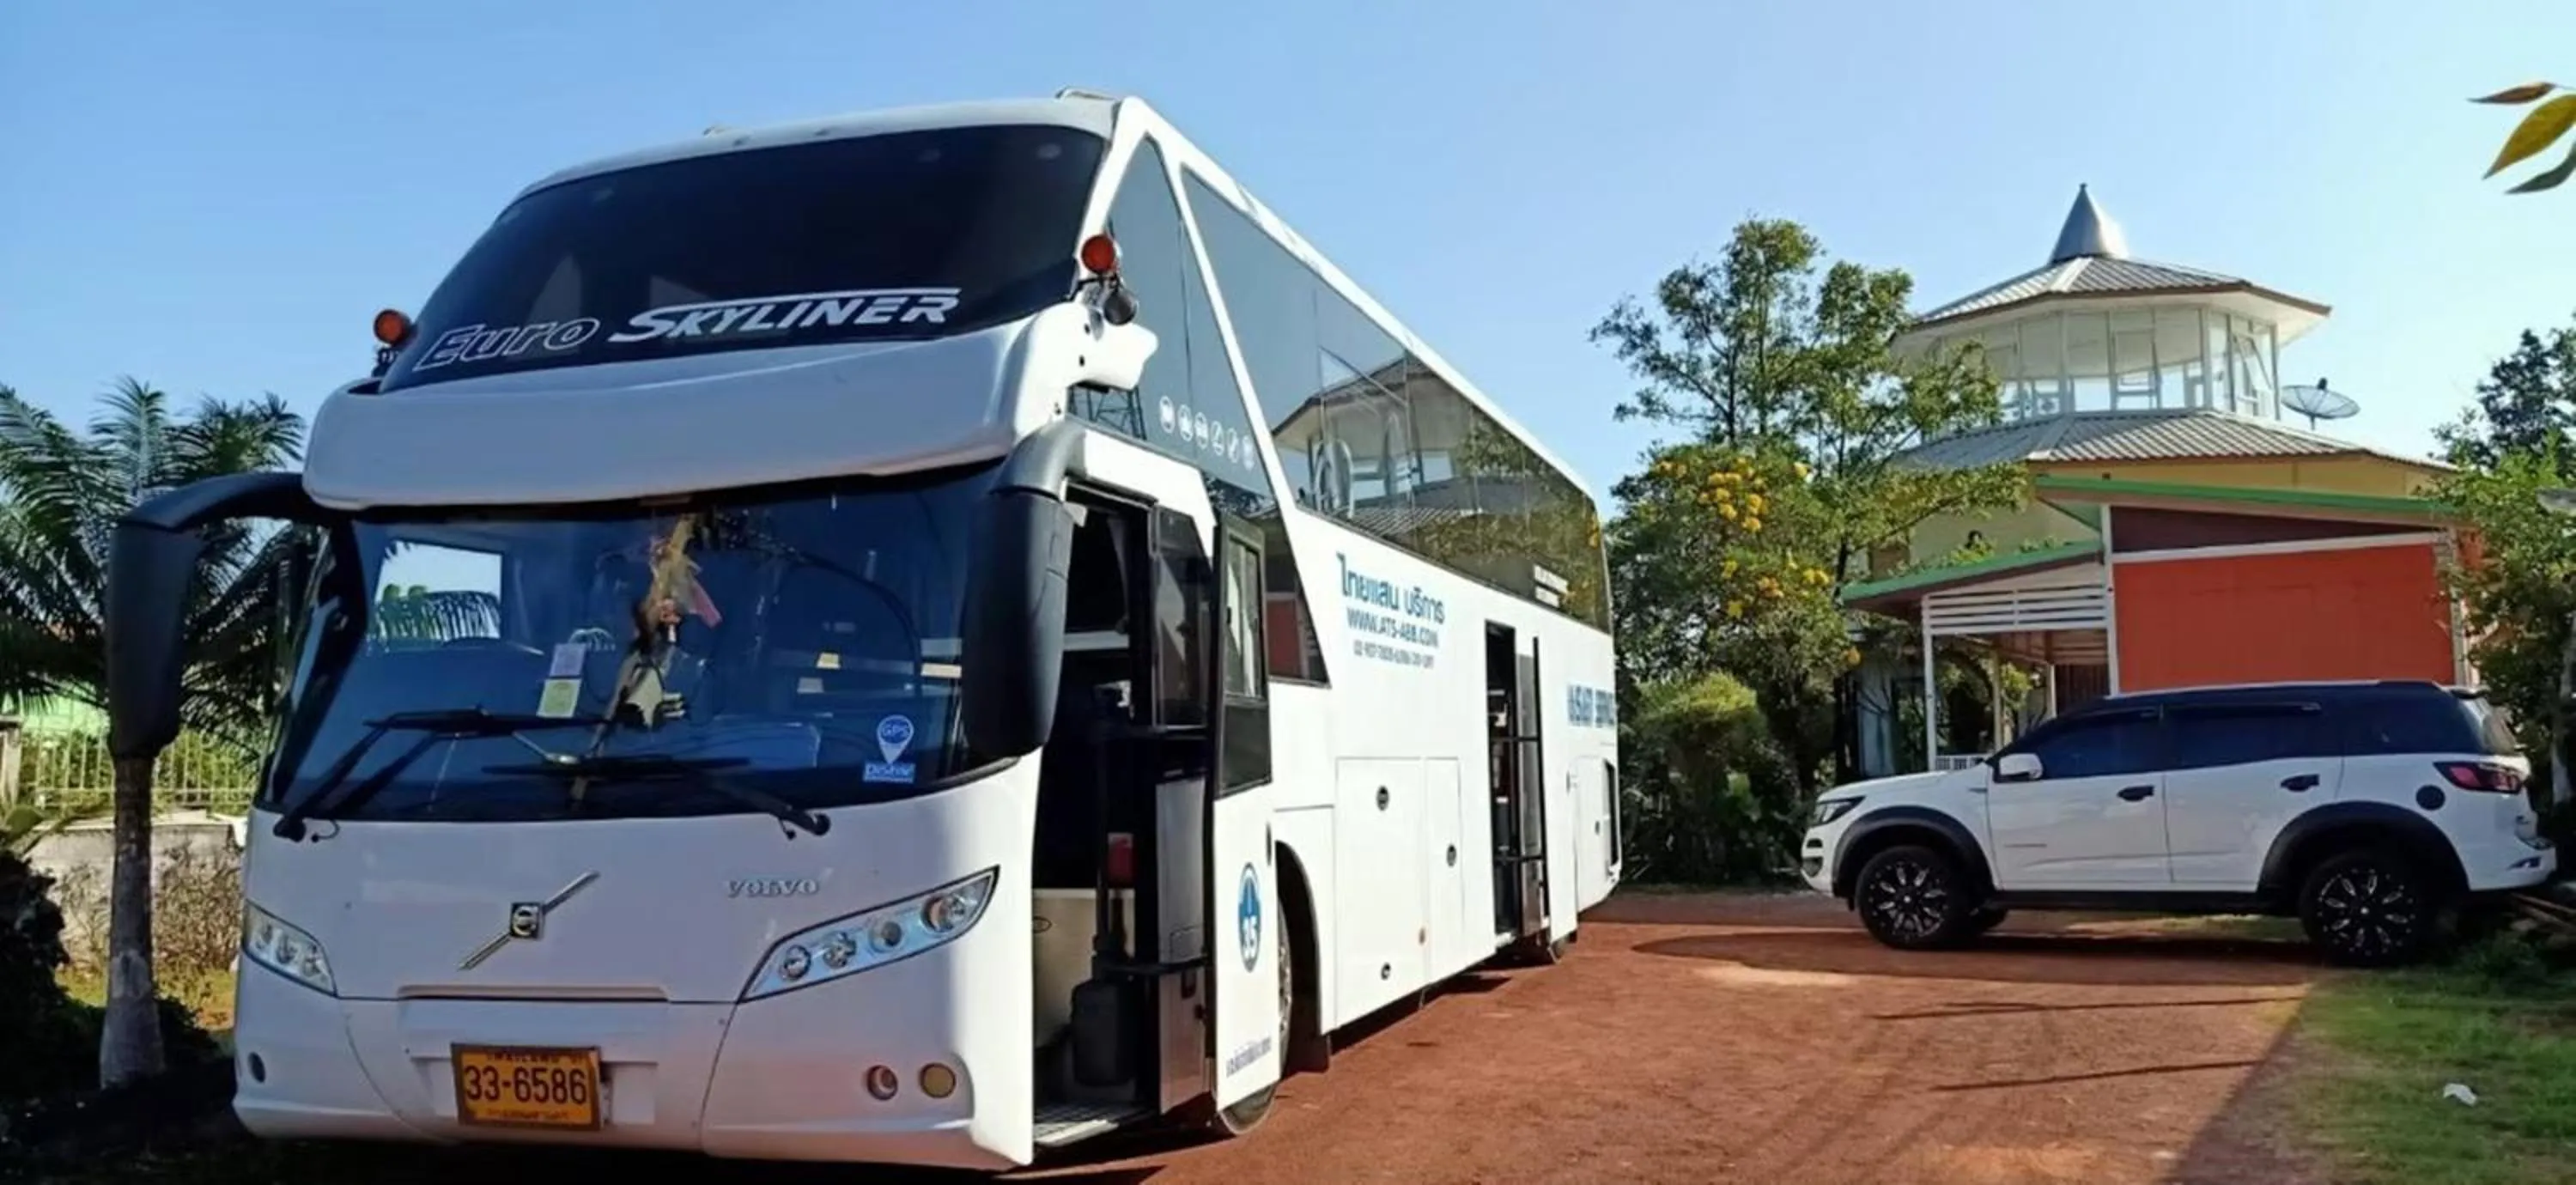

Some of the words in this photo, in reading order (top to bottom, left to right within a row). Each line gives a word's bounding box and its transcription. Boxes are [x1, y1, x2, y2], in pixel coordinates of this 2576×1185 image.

[413, 319, 600, 373] Euro
[608, 288, 962, 343] SKYLINER
[882, 722, 909, 738] GPS
[728, 878, 819, 898] VOLVO
[464, 1065, 587, 1104] 33-6586
